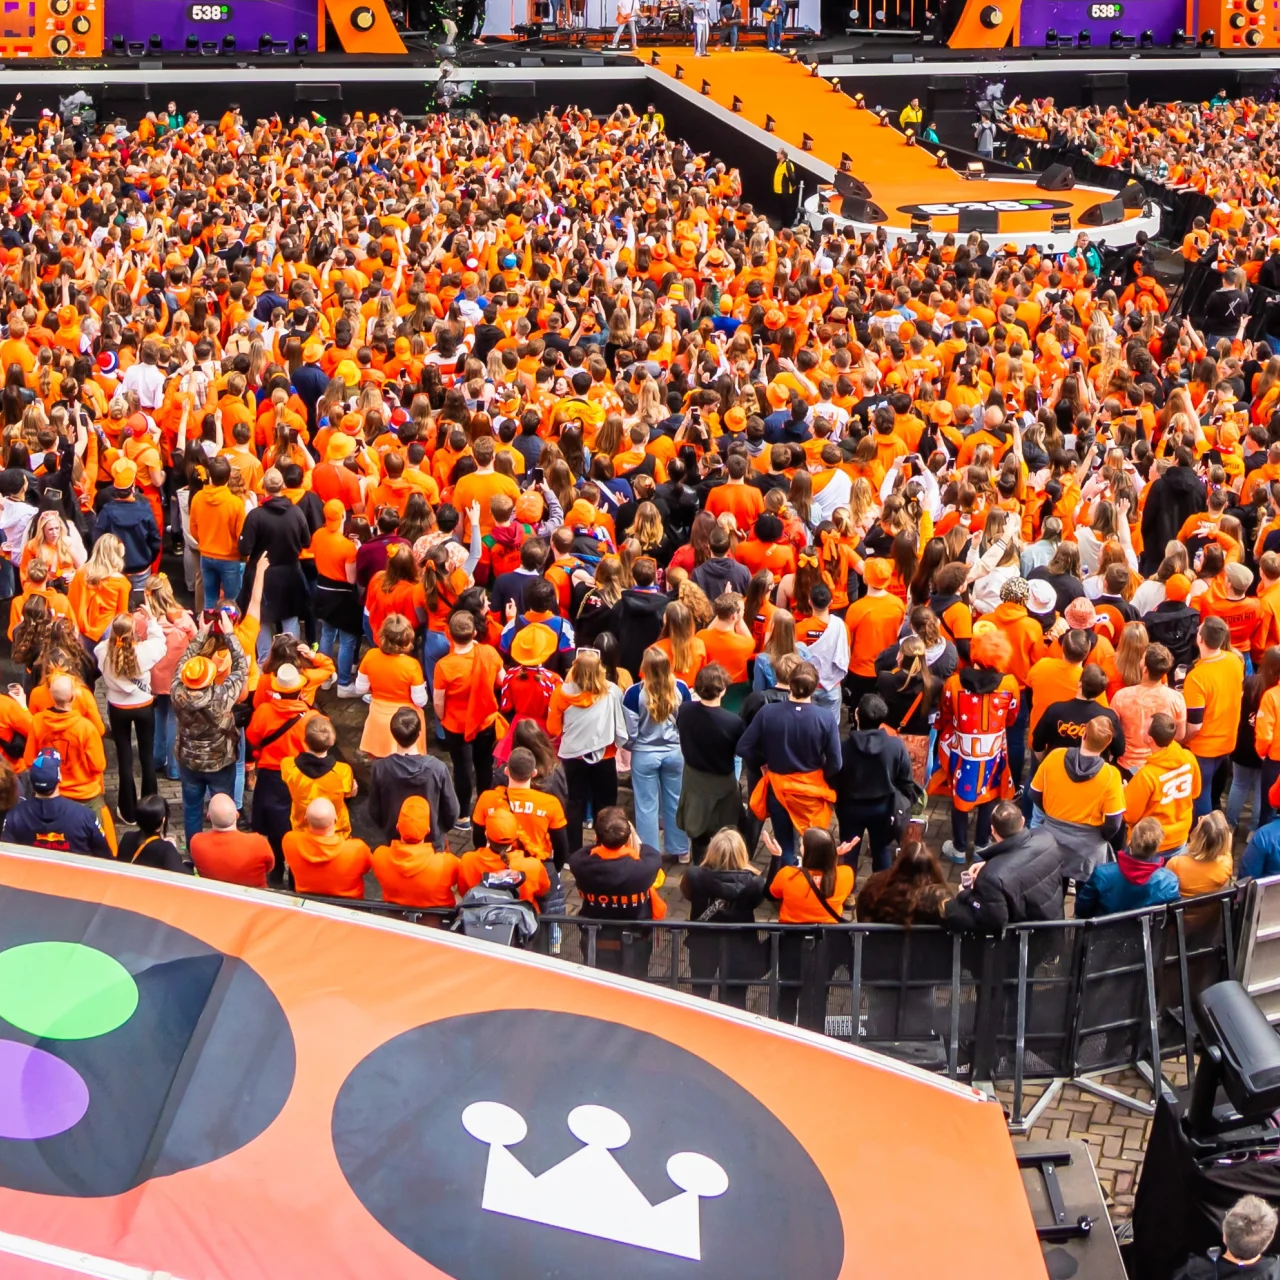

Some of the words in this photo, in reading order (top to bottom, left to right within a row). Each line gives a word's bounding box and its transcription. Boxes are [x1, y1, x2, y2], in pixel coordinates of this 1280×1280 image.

[192, 5, 221, 20] 538
[1091, 4, 1114, 18] 538
[1160, 772, 1193, 805] 33
